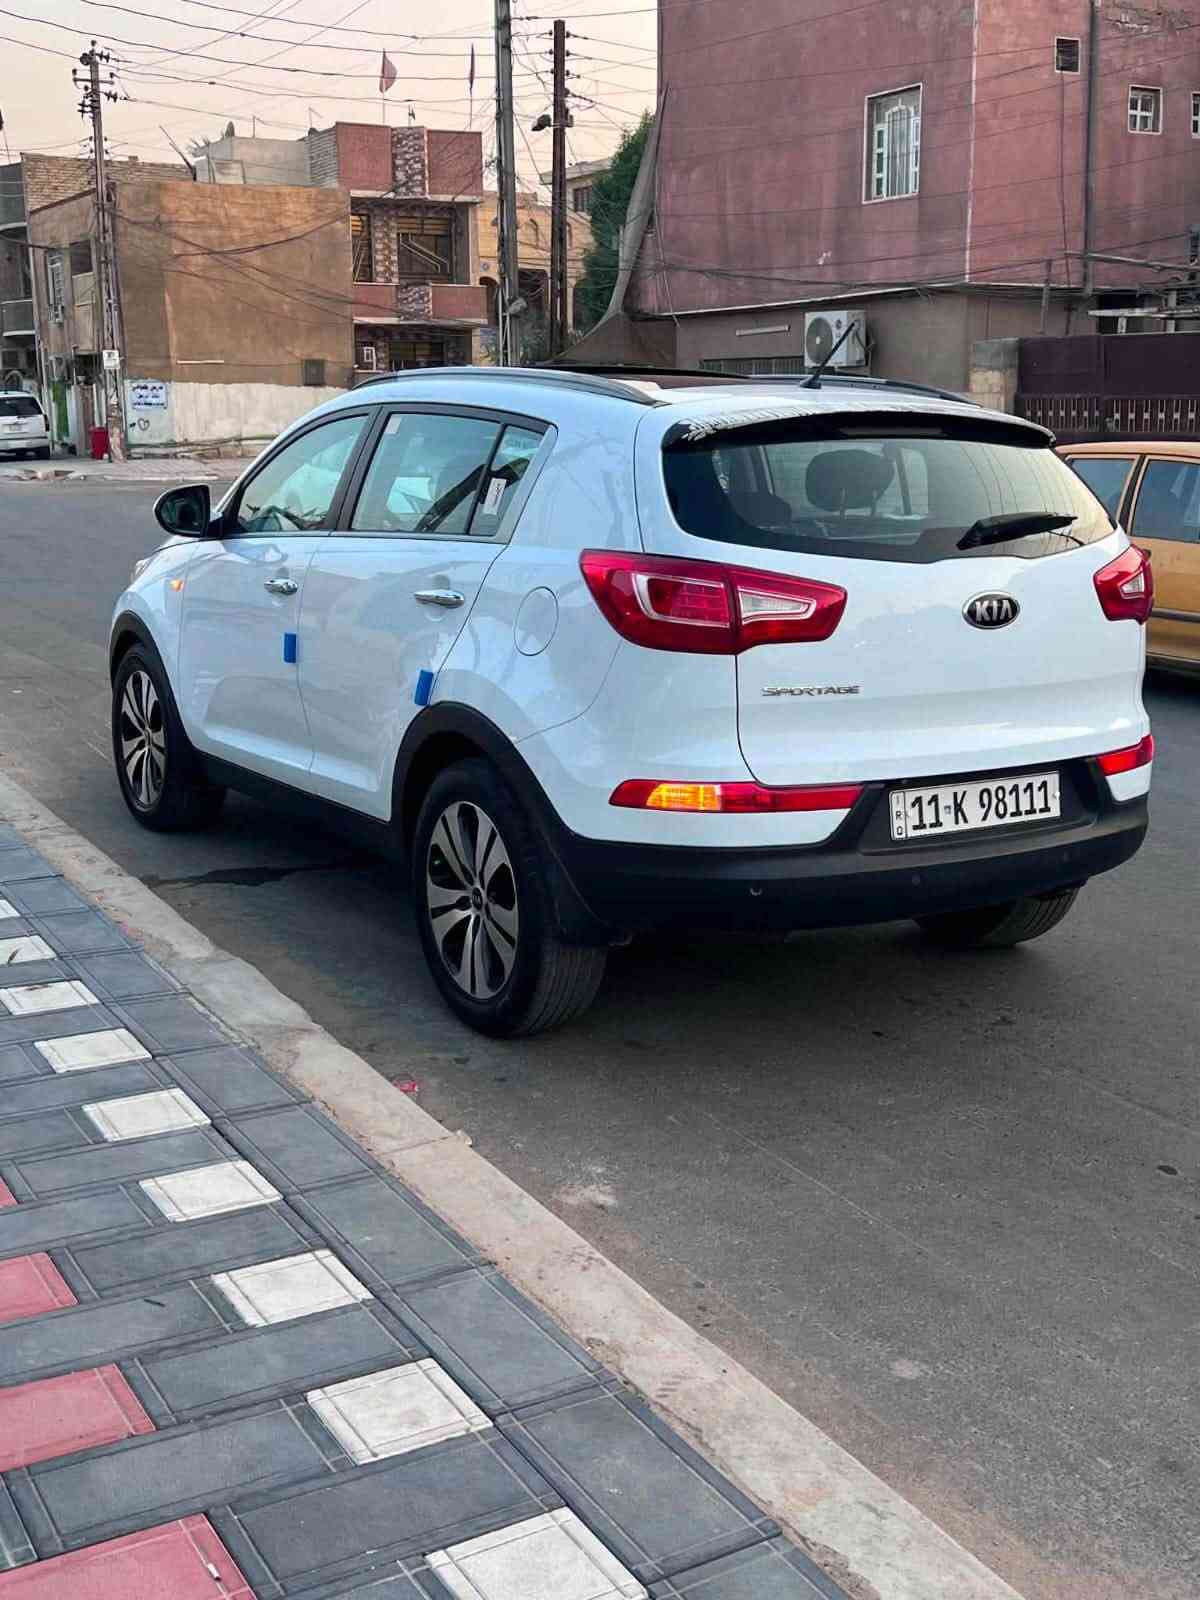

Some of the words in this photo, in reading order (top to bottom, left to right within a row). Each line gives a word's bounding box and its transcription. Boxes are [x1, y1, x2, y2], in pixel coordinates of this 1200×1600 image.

[975, 599, 1013, 622] KIA
[761, 685, 862, 697] SPORTAGE
[911, 793, 943, 831] 11
[953, 790, 968, 825] K
[979, 780, 1051, 821] 98111
